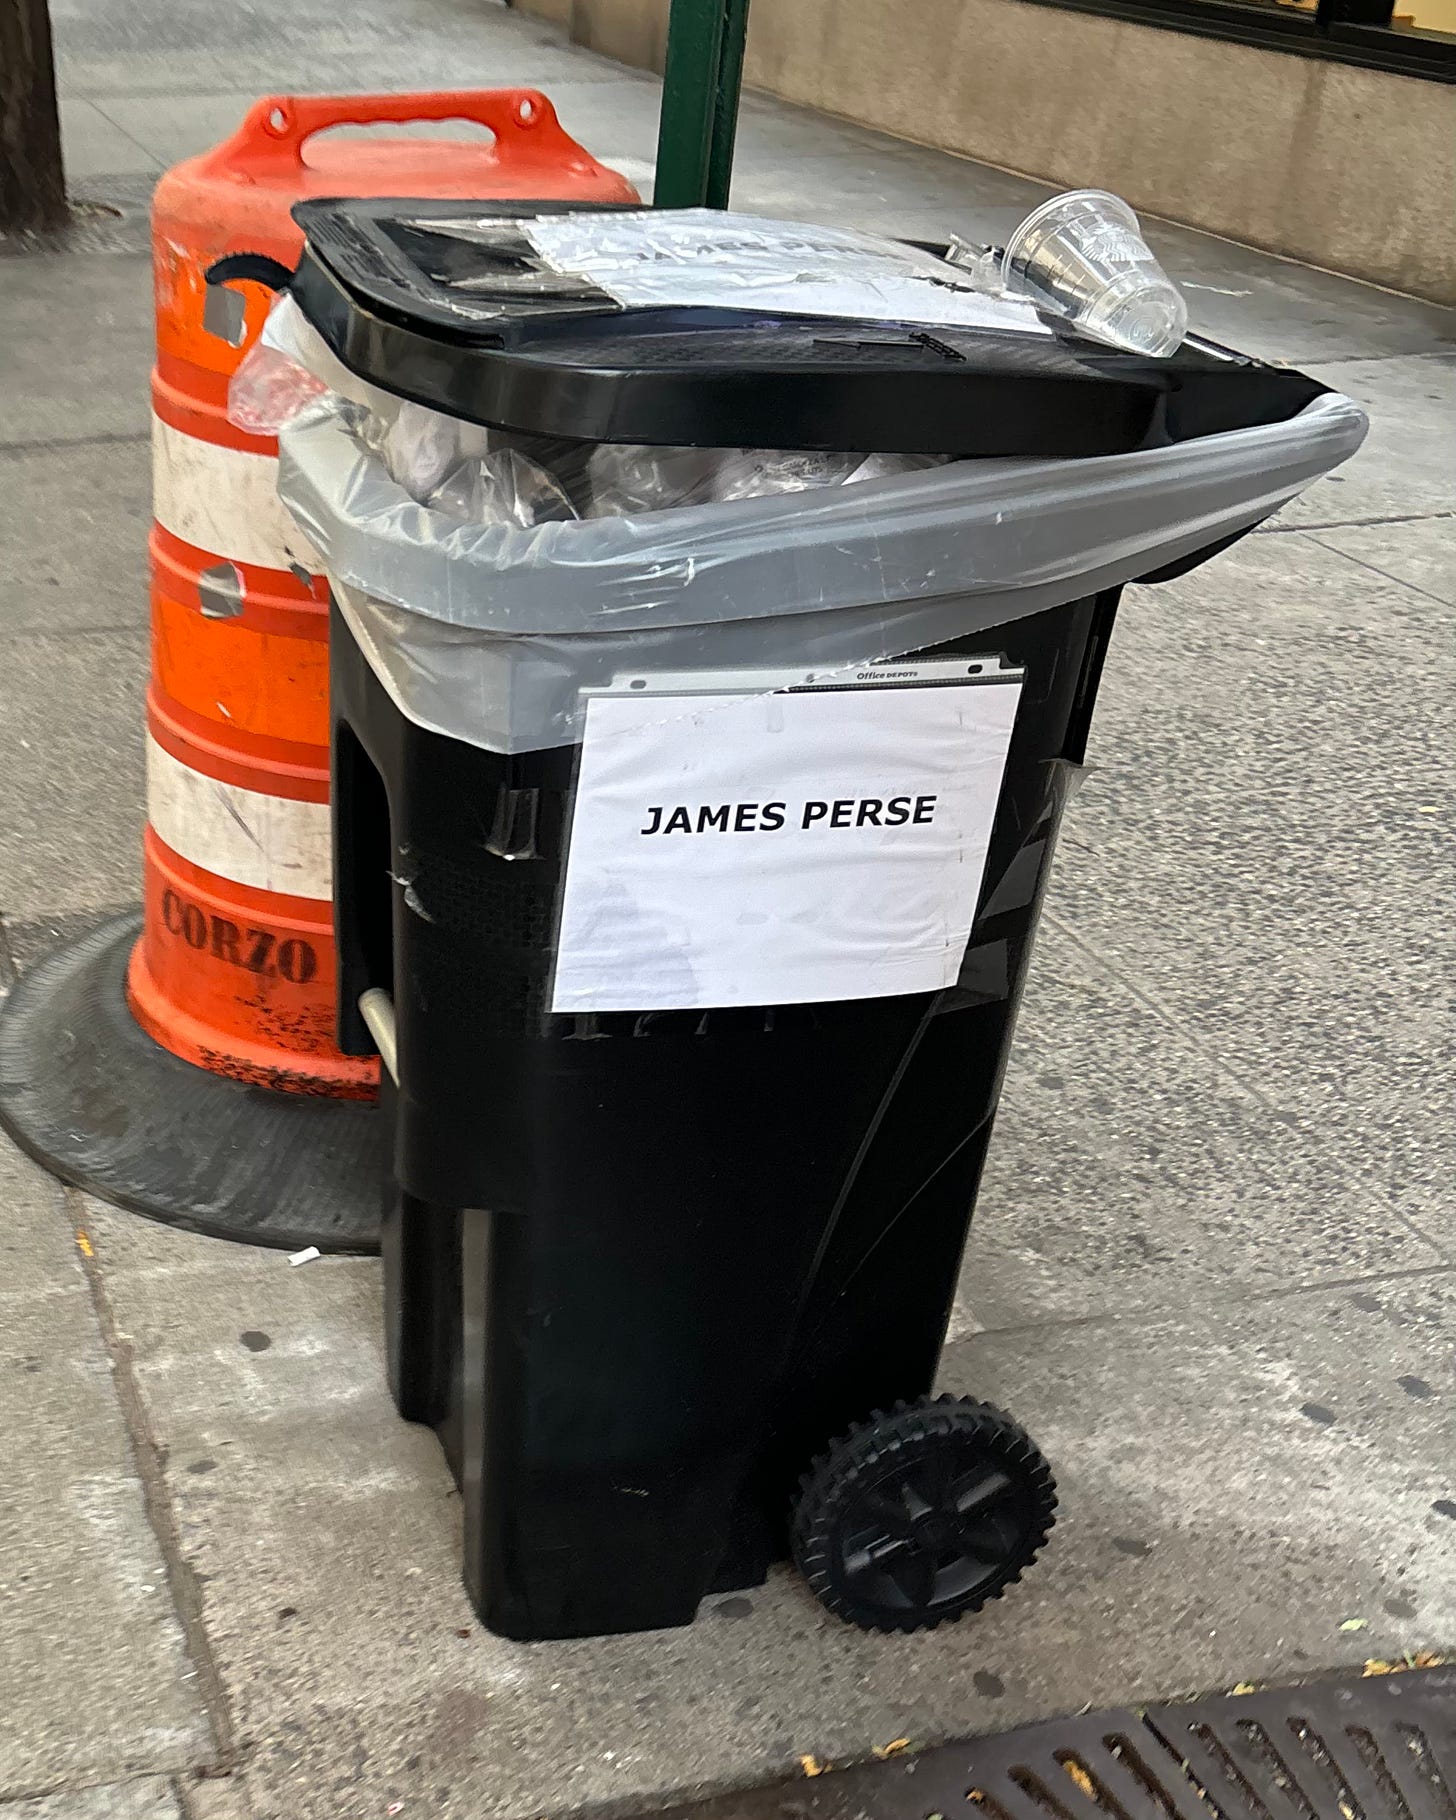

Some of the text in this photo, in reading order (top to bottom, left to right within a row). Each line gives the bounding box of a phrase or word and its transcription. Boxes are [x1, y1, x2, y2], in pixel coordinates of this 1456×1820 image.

[857, 671, 886, 681] Office
[641, 795, 938, 835] JAMES PERSE
[162, 888, 317, 984] CORZO
